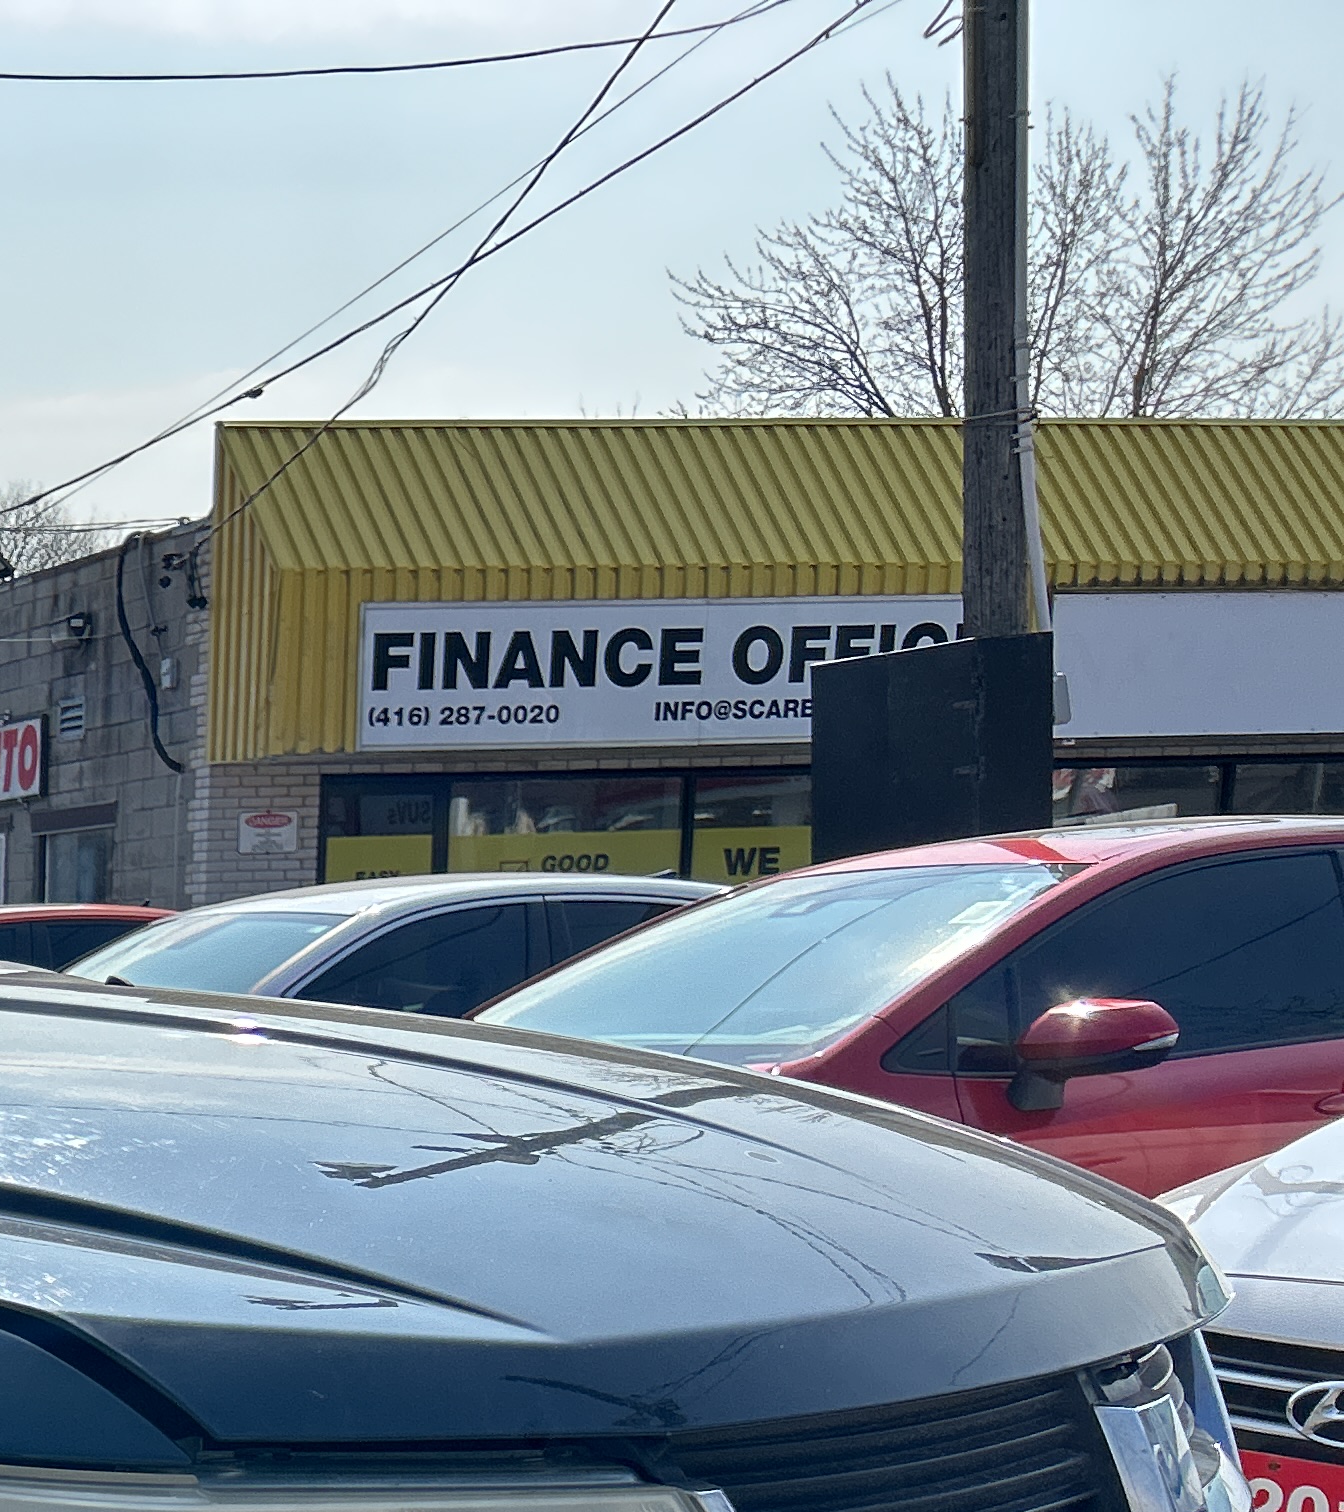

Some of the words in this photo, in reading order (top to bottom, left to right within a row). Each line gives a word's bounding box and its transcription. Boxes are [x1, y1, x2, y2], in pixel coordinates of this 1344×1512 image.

[371, 627, 705, 691] FINANCE
[732, 622, 965, 685] OFFI
[367, 706, 430, 727] (416)
[439, 704, 560, 726] 287-0020
[541, 853, 609, 872] GOOD
[724, 847, 780, 875] WE
